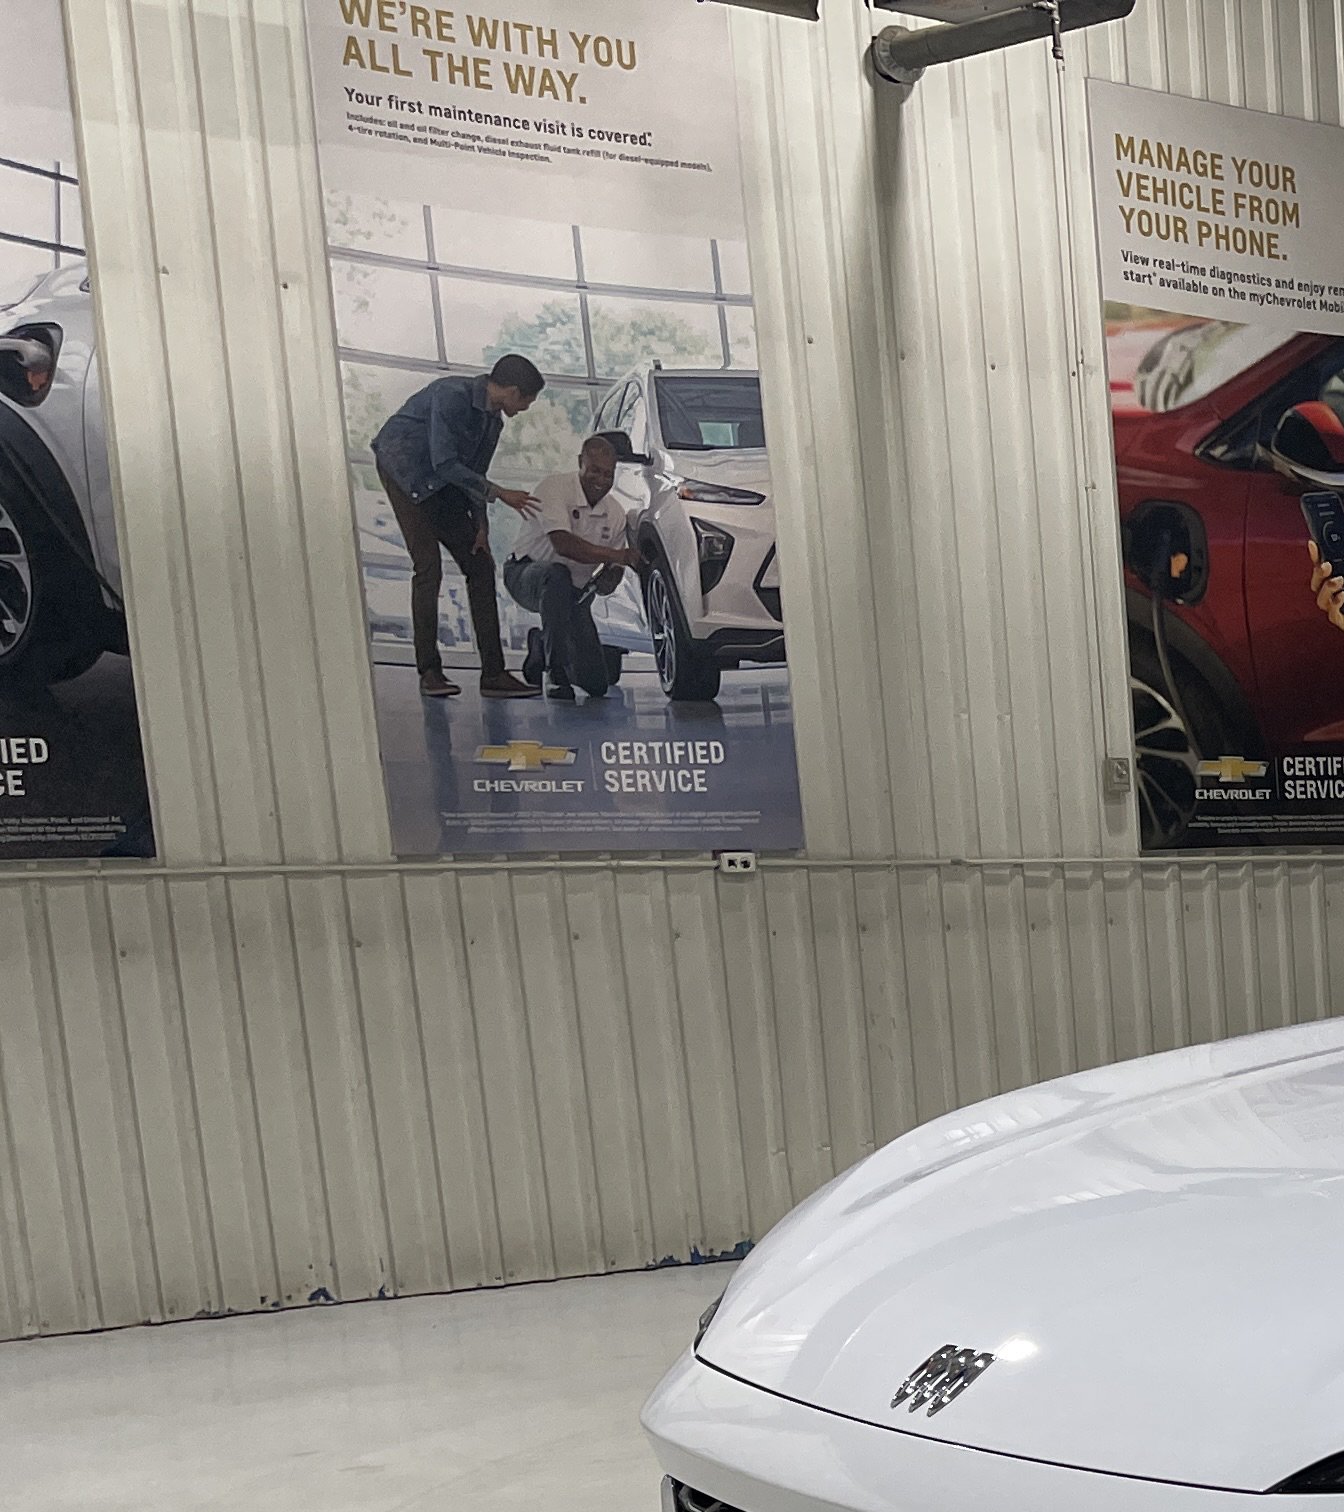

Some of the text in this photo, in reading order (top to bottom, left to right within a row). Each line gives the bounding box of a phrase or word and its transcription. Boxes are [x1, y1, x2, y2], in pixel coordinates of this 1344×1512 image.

[340, 0, 638, 71] WE'RE WITH YOU
[343, 35, 587, 104] ALL THE WAY.
[344, 86, 383, 107] Your
[387, 94, 424, 115] first
[428, 104, 530, 131] maintenance
[534, 118, 568, 136] visit
[571, 122, 584, 138] is
[1114, 132, 1297, 193] MANAGE YOUR
[1115, 168, 1300, 229] VEHICLE FROM
[1118, 204, 1288, 261] YOUR PHONE.
[1120, 249, 1150, 266] View
[1152, 256, 1207, 278] real-time
[1209, 266, 1272, 288] diagnostics
[1275, 277, 1294, 291] and
[1297, 281, 1325, 298] enjoy
[1159, 276, 1209, 295] available
[1211, 285, 1226, 297] on
[1228, 286, 1246, 301] the
[1249, 290, 1317, 313] myChevrolet
[601, 741, 725, 765] CERTIFIED
[473, 779, 585, 793] CHEVROLET
[604, 769, 708, 793] SERVICE
[1195, 788, 1272, 800] CHEVROLET
